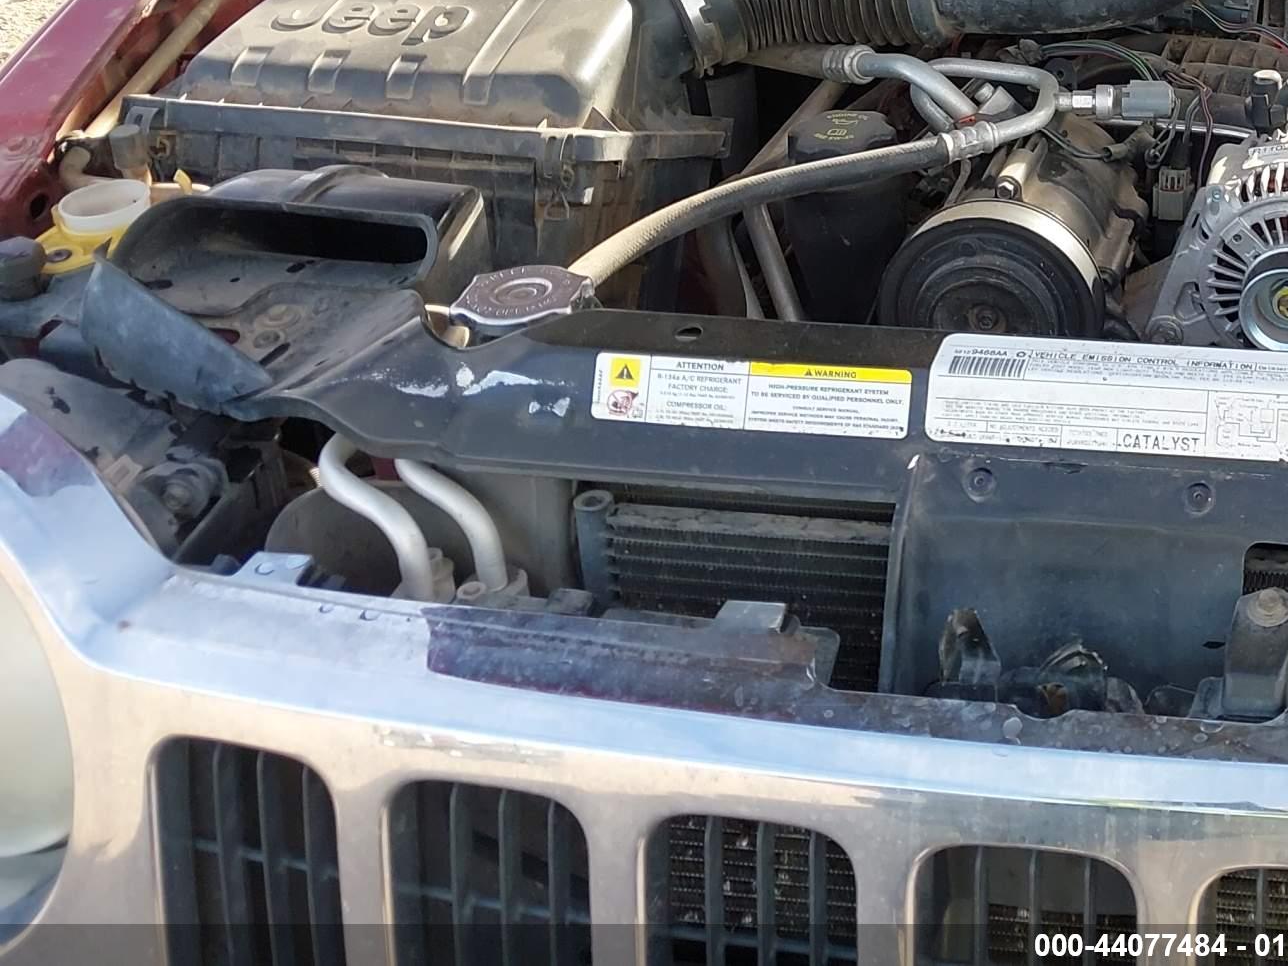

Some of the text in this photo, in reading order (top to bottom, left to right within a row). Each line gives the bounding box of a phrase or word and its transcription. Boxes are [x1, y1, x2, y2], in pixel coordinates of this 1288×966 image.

[676, 361, 724, 371] ATTENTION
[1035, 351, 1253, 371] VEHICLE EMISSION CONTROL INFORMATION
[814, 369, 857, 379] WARNING
[696, 376, 742, 385] REFRIGERANT
[668, 383, 698, 392] FACTORY
[820, 386, 863, 394] REFRIGERANT
[770, 392, 801, 400] SERVICED
[811, 394, 845, 402] QUALIFIED
[846, 396, 884, 404] PERSONNEL
[666, 400, 712, 409] COMPRESSOR
[1122, 433, 1201, 452] CATALYST
